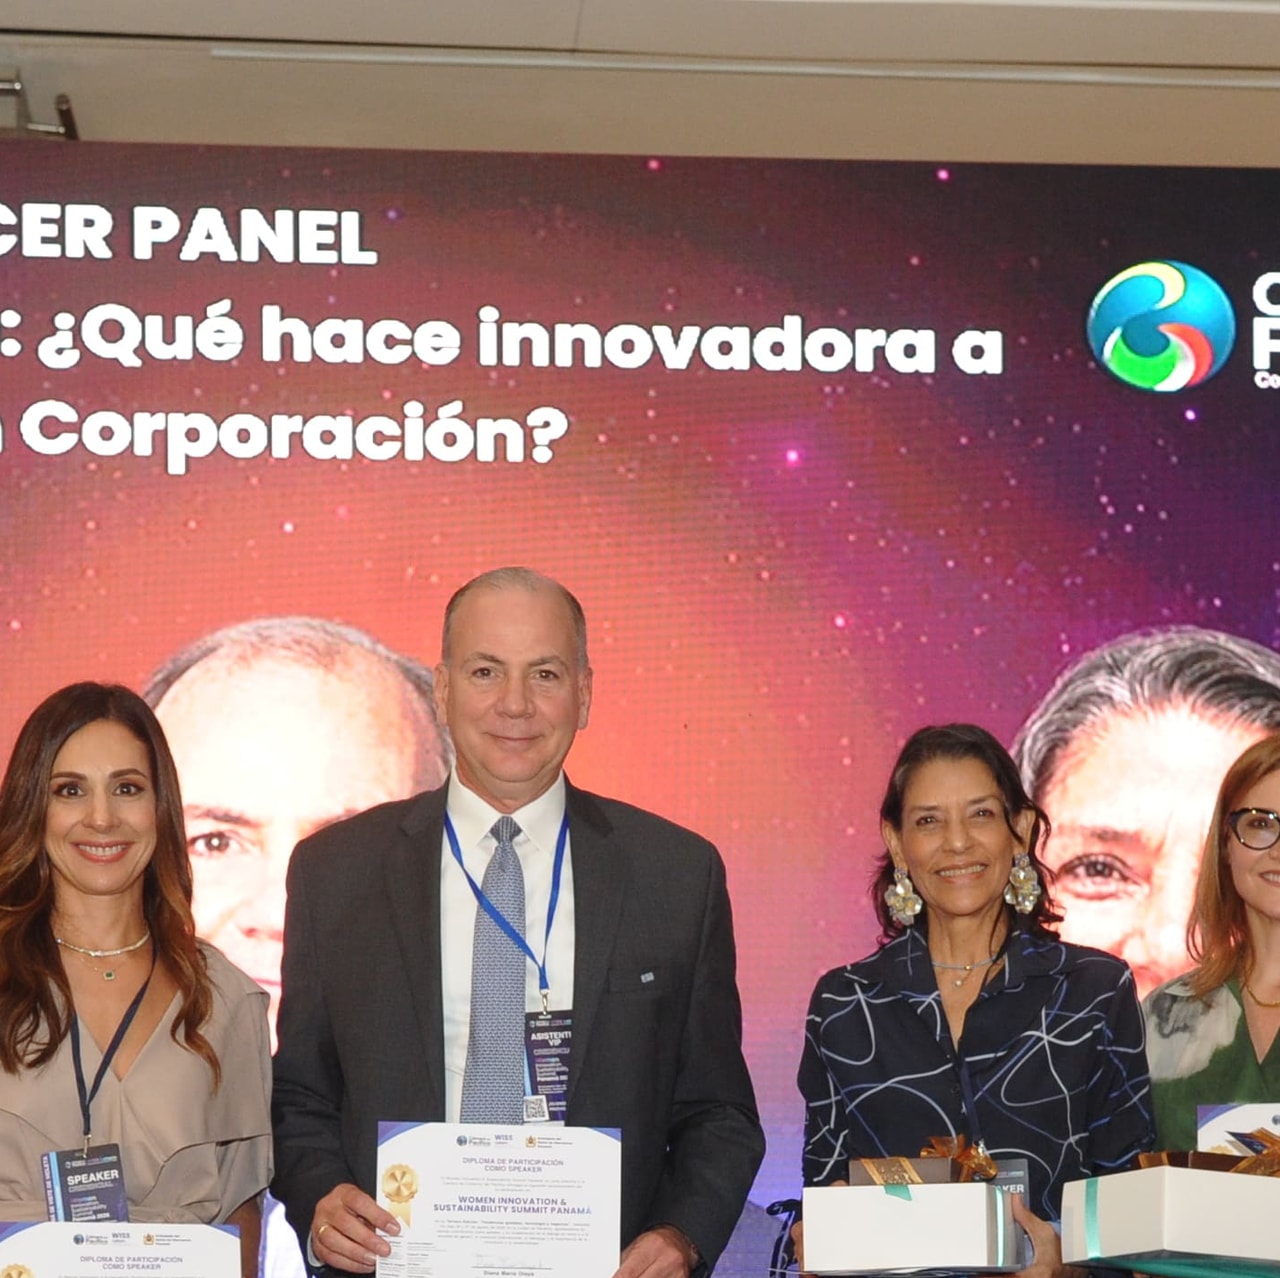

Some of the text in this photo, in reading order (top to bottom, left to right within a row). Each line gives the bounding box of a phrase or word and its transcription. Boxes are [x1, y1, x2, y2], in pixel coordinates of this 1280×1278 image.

[133, 205, 378, 265] PANEL
[37, 298, 244, 369] ¿Qué
[261, 304, 461, 366] hace
[478, 305, 936, 374] innovadora
[951, 330, 1003, 375] a
[19, 399, 568, 476] Corporación?
[462, 1157, 495, 1165] DIPLOMA
[508, 1165, 542, 1173] SPEAKER
[66, 1169, 119, 1185] SPEAKER
[458, 1196, 567, 1206] WOMEN INNOVATION &
[433, 1203, 508, 1213] SUSTAINABILITY
[511, 1205, 547, 1214] SUMMIT
[80, 1255, 113, 1263] DIPLOMA
